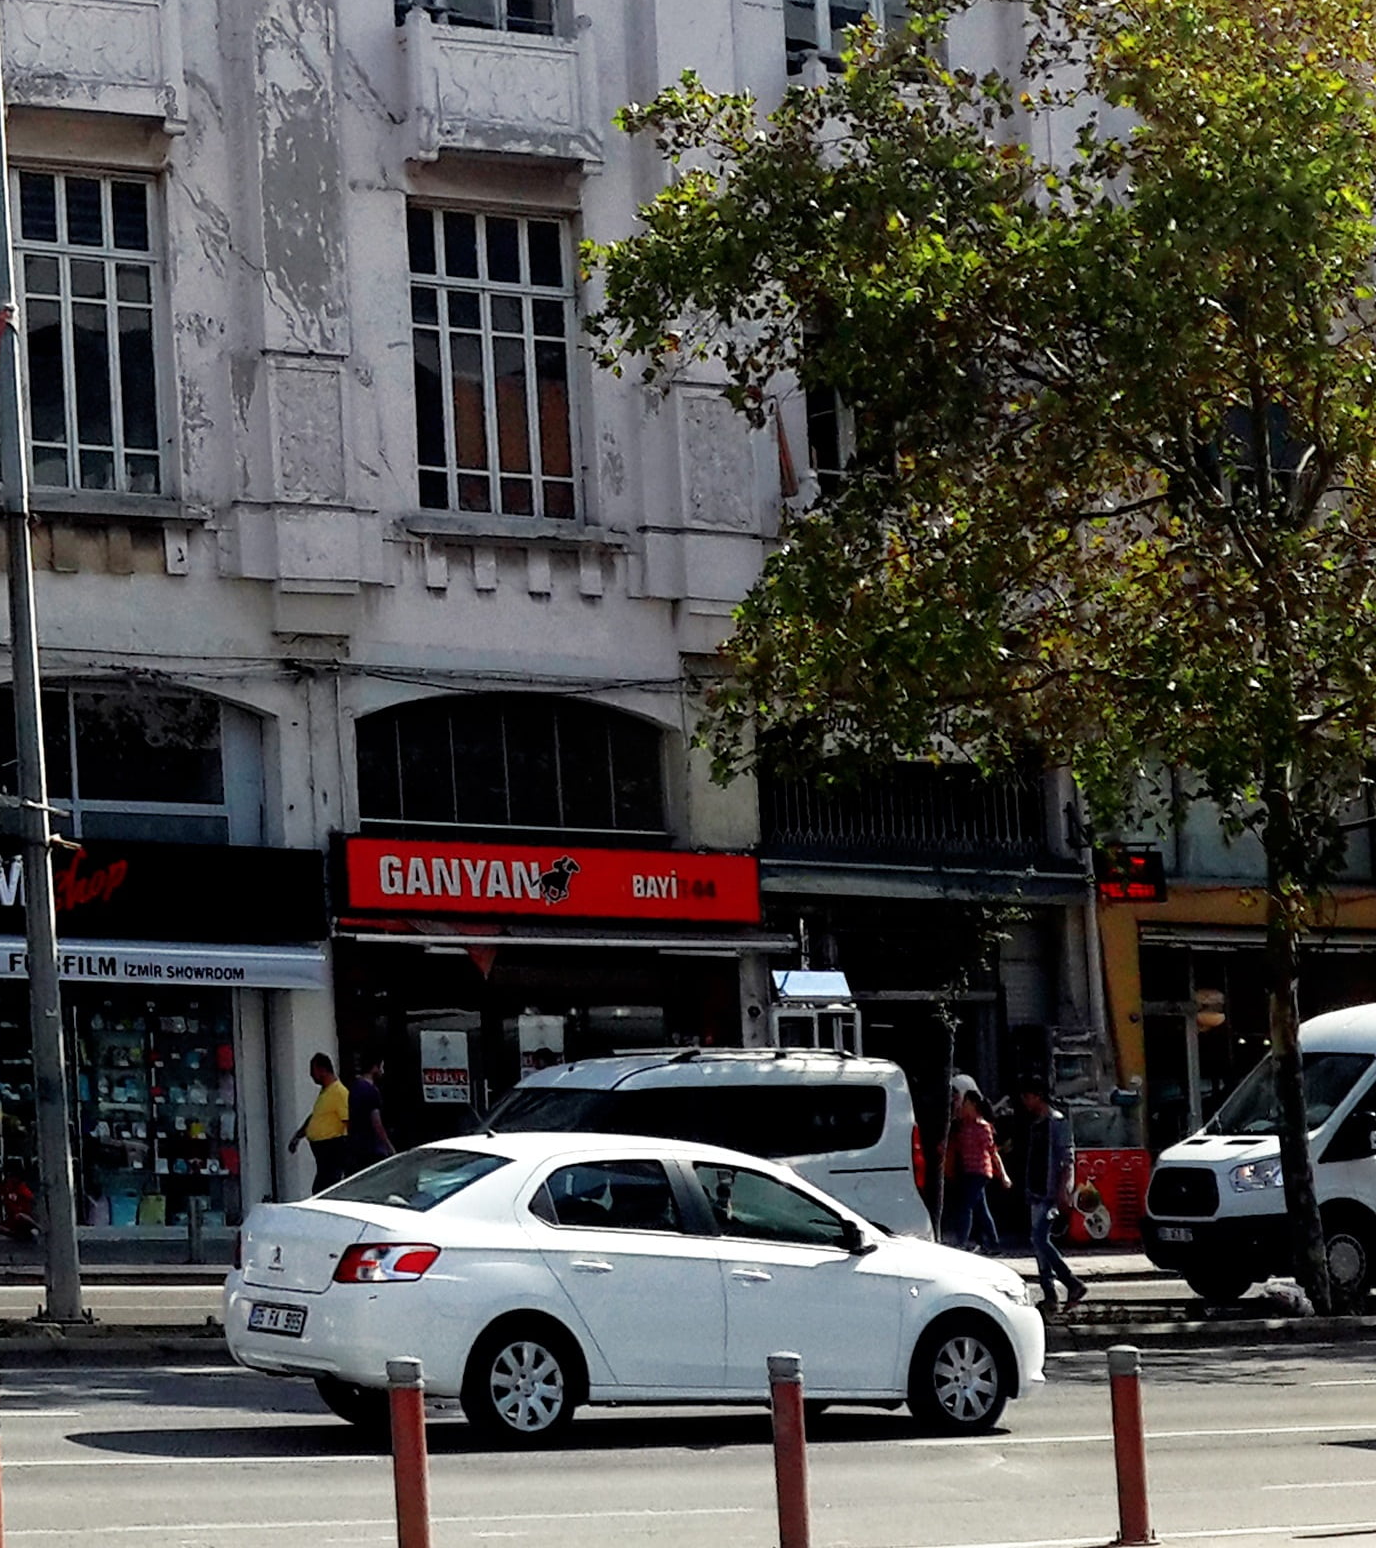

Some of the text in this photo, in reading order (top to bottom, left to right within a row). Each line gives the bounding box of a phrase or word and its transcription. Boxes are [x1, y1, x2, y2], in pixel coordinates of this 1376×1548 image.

[379, 854, 541, 900] GANYAN
[632, 869, 678, 899] BAYİ
[8, 953, 245, 981] FFILM İZMİR SHOWROOM
